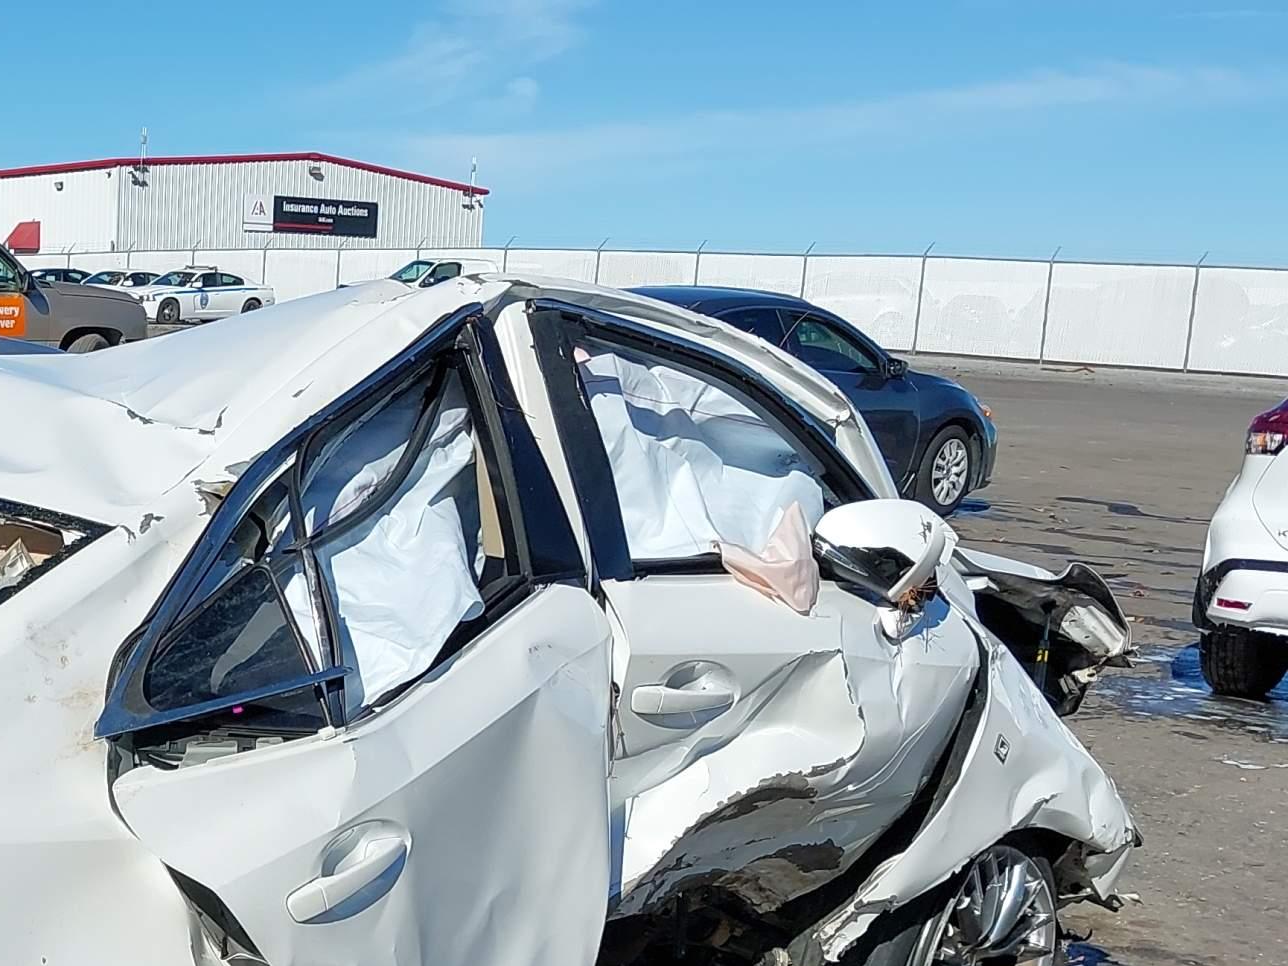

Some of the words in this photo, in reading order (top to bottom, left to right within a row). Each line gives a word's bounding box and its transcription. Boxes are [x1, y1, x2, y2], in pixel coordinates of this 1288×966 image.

[283, 201, 318, 214] Insurance
[320, 203, 336, 215] Auto
[338, 204, 369, 217] Auctions
